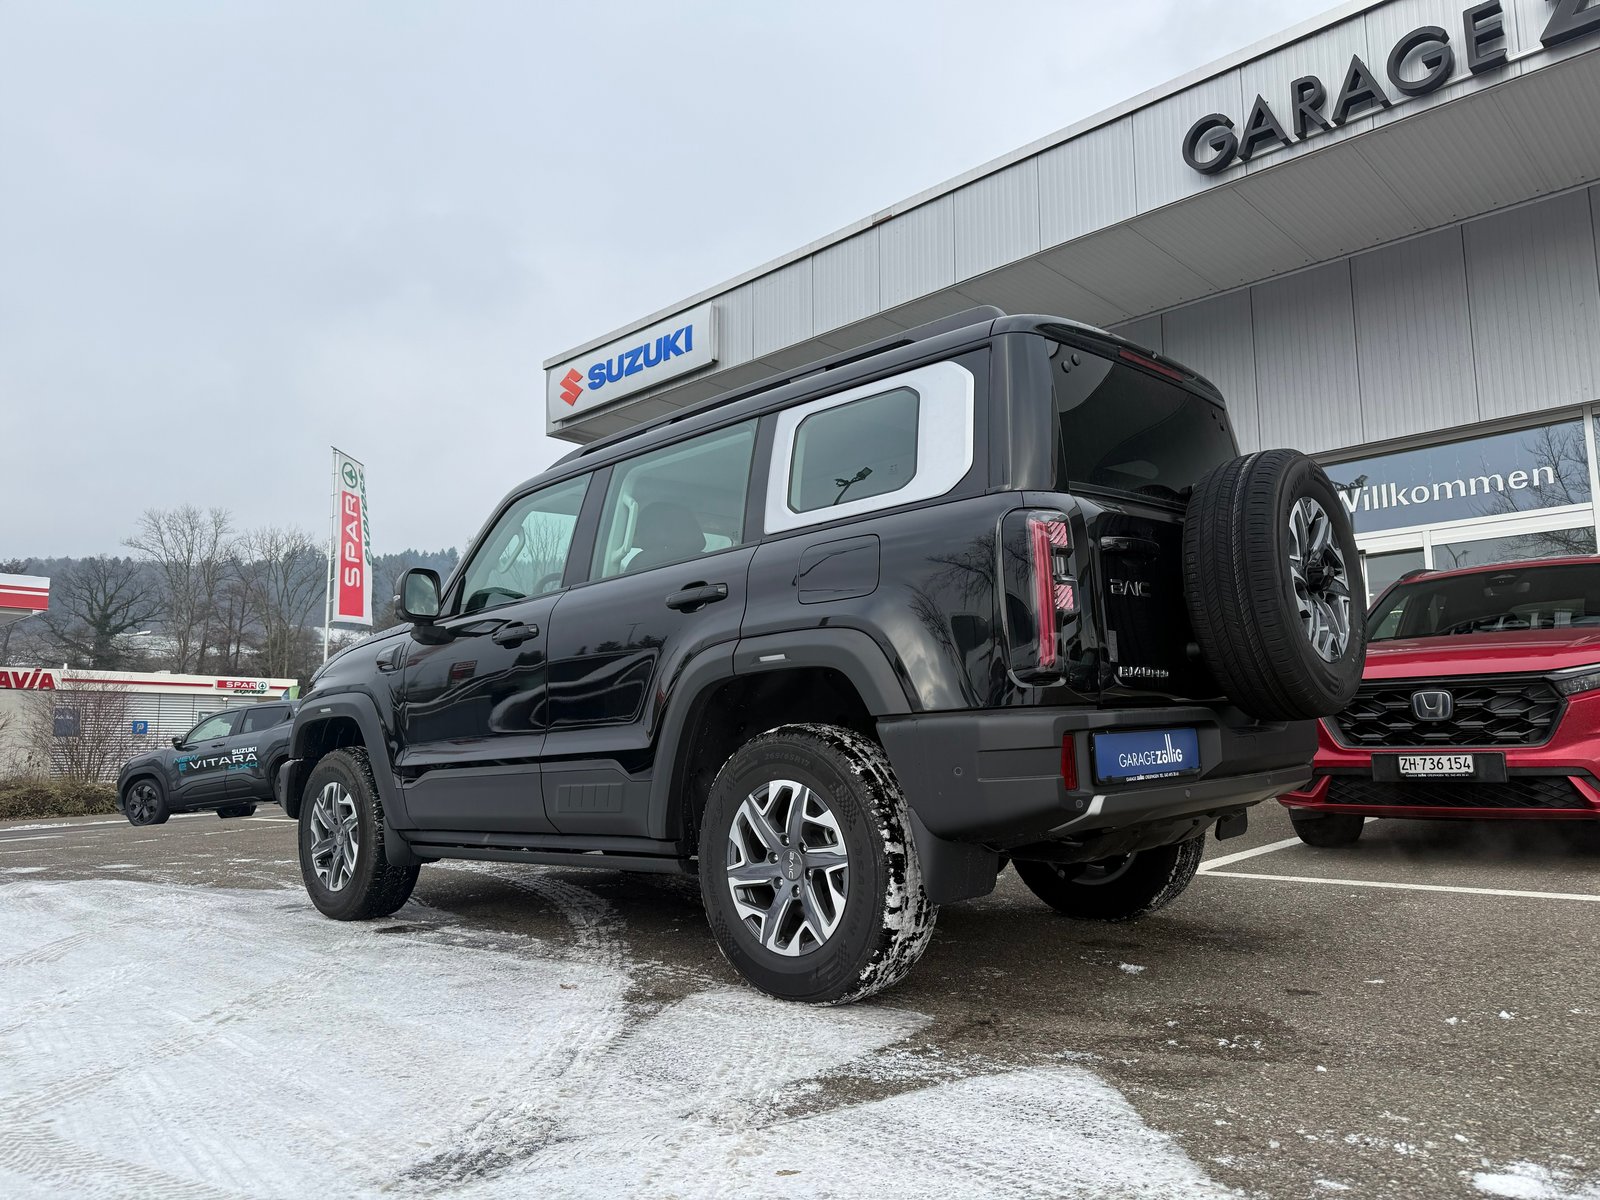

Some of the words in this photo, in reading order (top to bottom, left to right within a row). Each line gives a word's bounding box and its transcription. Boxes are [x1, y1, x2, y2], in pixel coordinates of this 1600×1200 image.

[1182, 0, 1508, 175] GARAGE
[587, 324, 693, 391] SUZUKI
[344, 495, 361, 588] SPAR
[226, 681, 257, 689] SPAR
[189, 753, 258, 769] VITARA
[231, 746, 257, 755] SUZUKI
